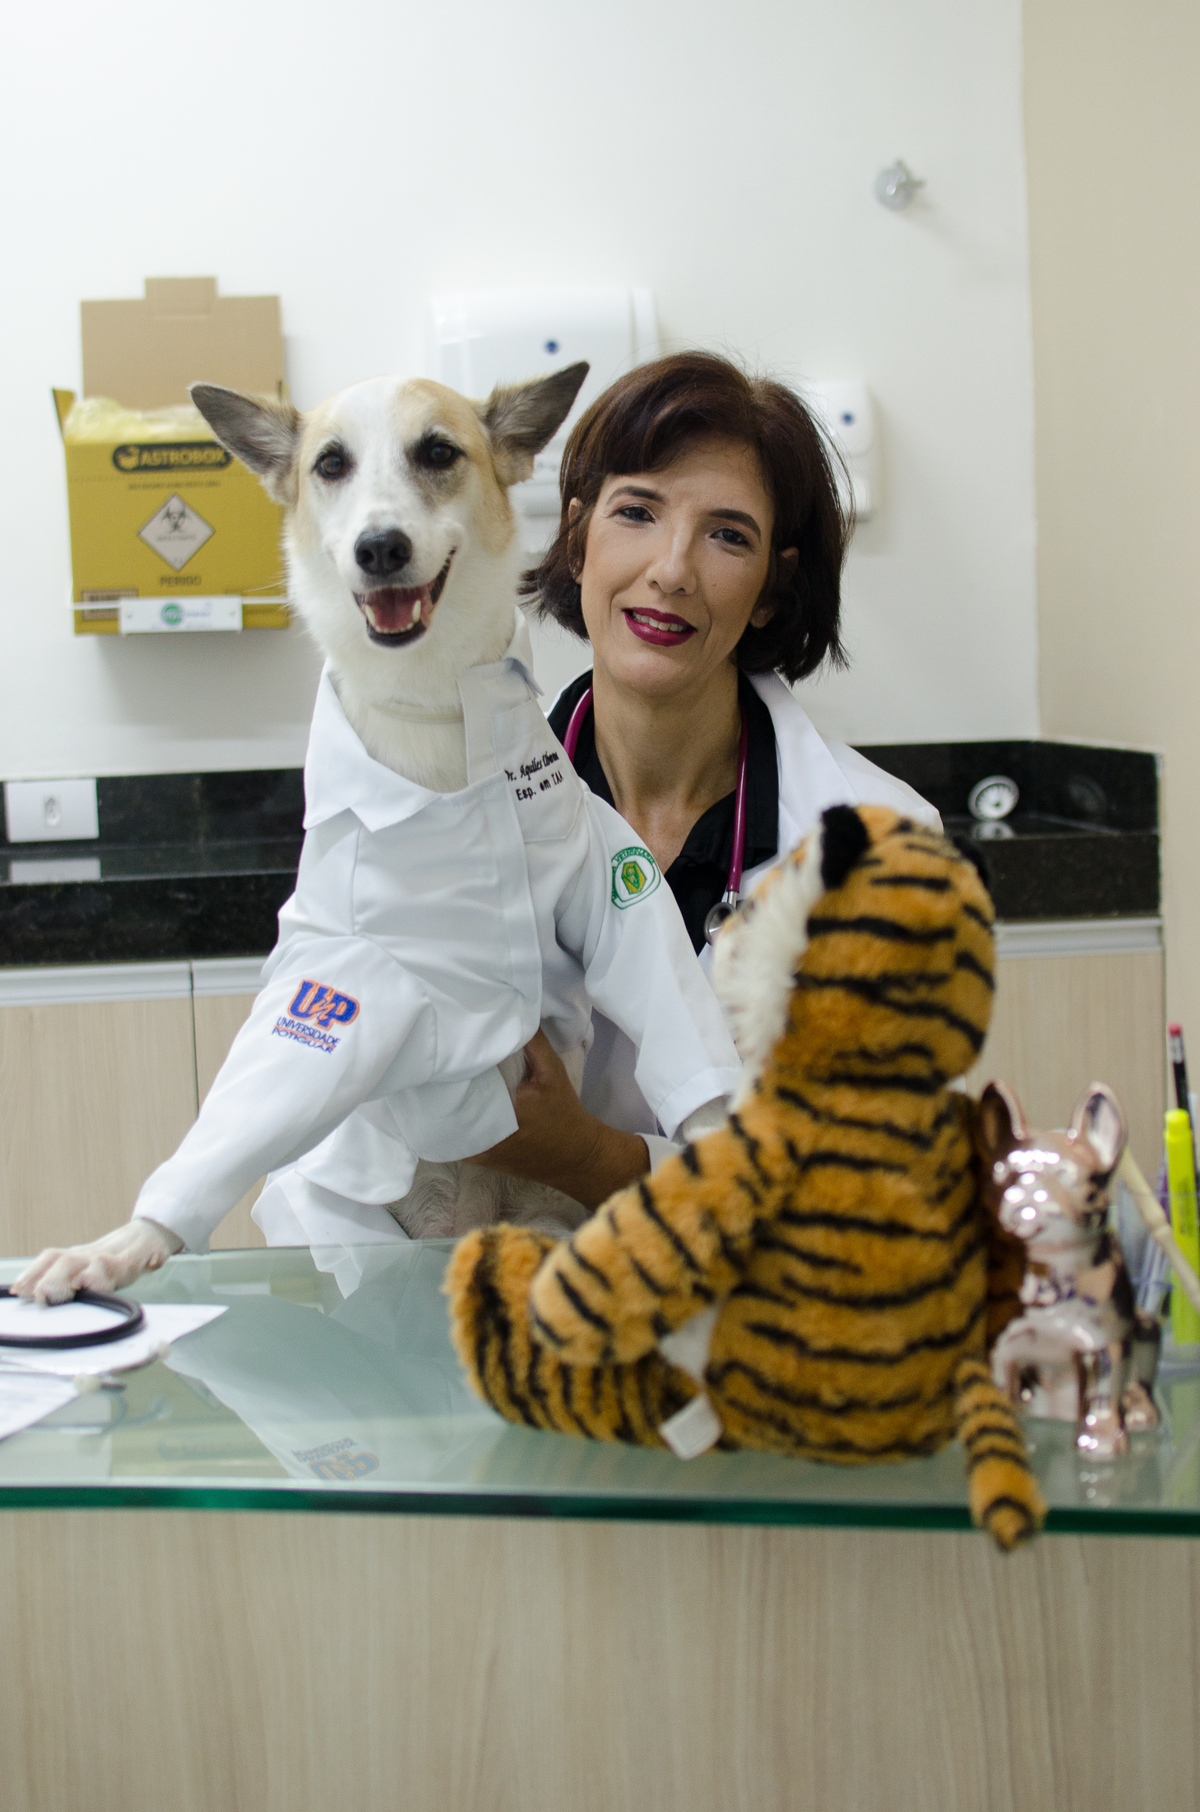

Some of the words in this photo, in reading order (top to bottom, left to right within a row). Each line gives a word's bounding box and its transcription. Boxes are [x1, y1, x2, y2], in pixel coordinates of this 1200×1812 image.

[140, 446, 227, 467] ASTROBOX
[160, 575, 202, 587] PERIGO
[515, 787, 537, 802] Esp.
[271, 1026, 335, 1054] POTIGUAR
[276, 1016, 341, 1045] UNIVERSIDADE
